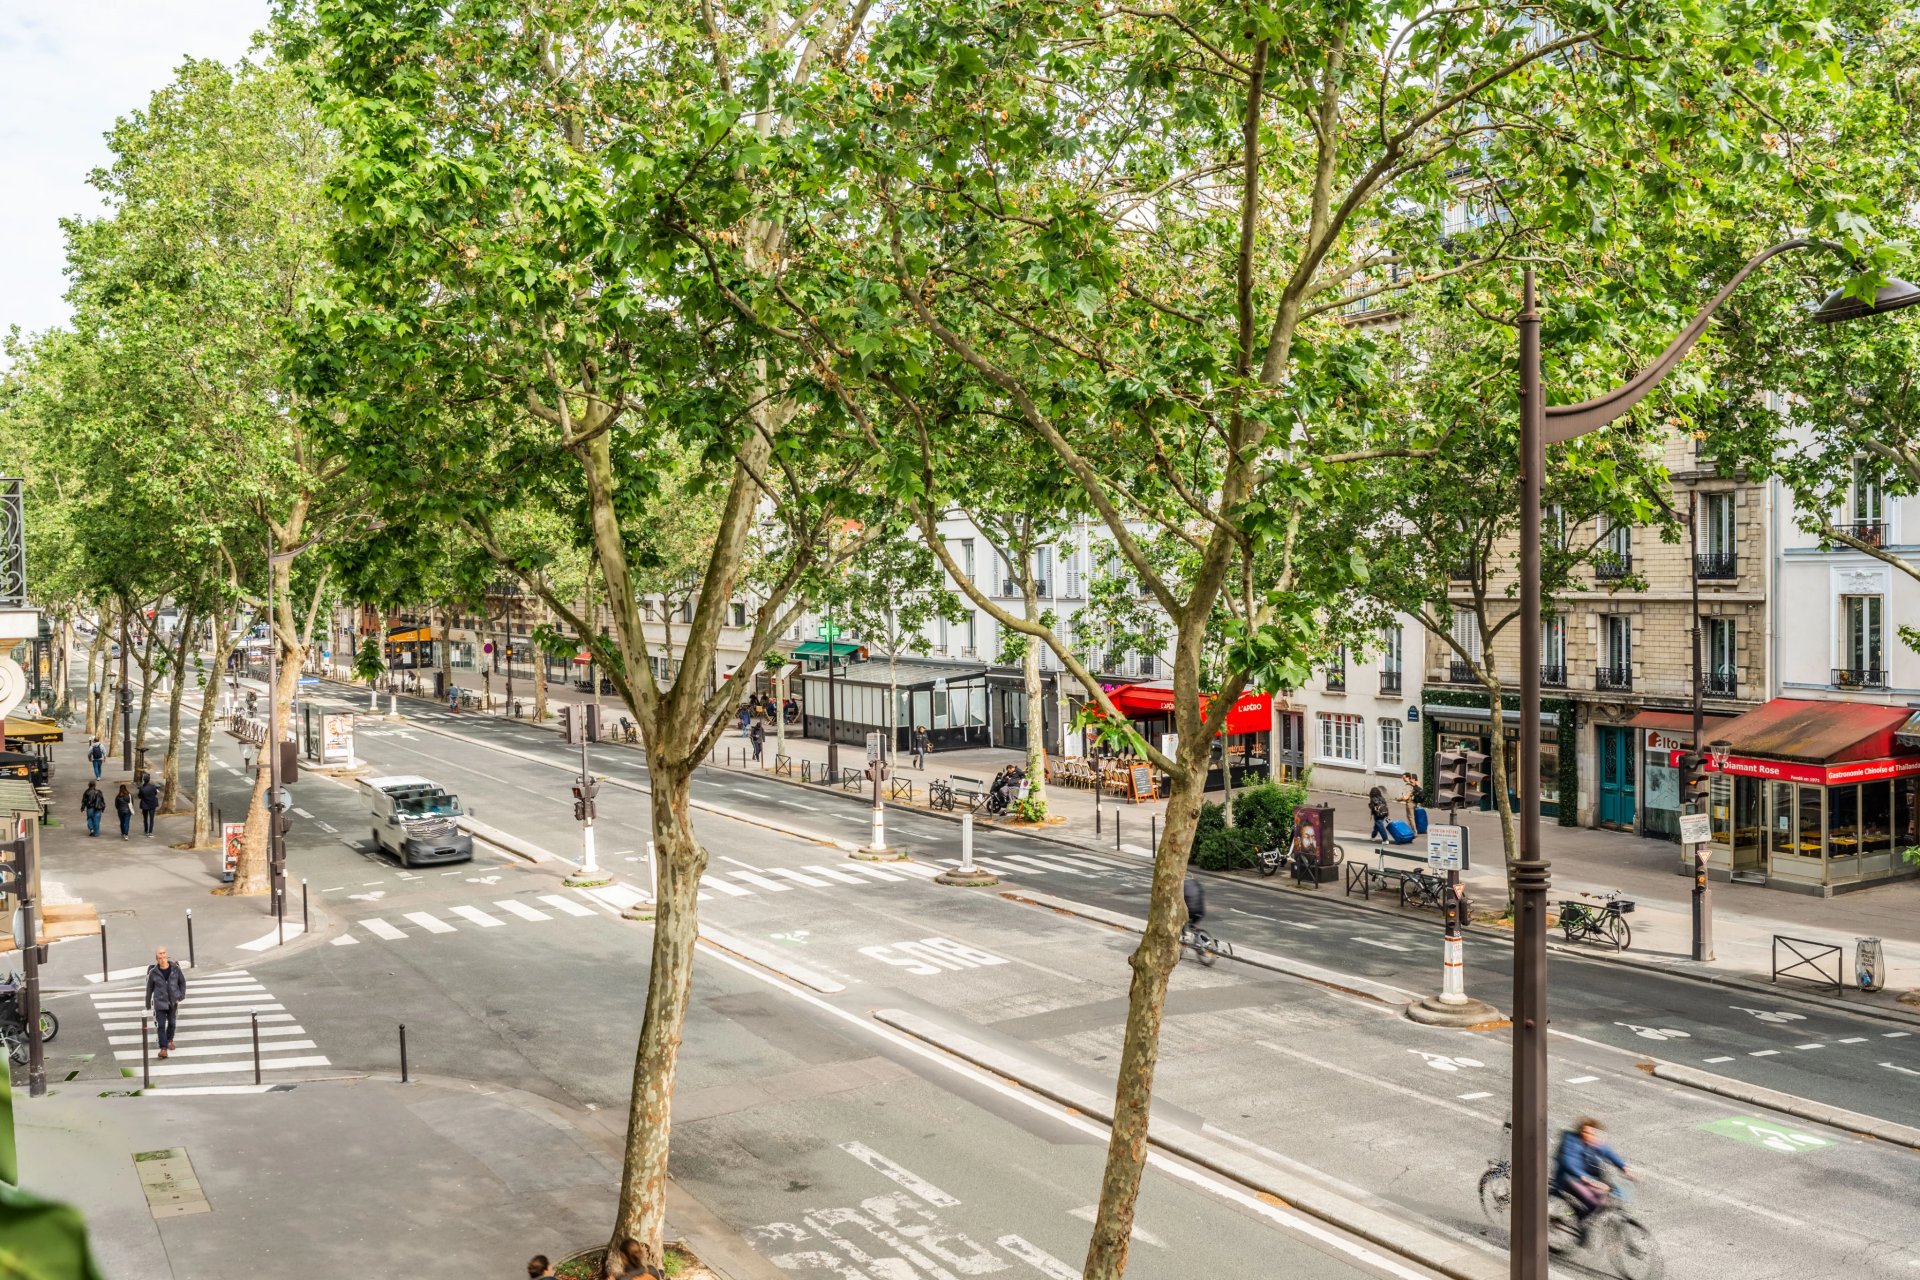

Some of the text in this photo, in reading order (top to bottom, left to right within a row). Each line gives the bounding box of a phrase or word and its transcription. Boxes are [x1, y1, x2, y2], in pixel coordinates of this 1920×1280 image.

[1238, 703, 1262, 713] L'APÉRO
[1723, 761, 1757, 773] Diamant
[1759, 765, 1780, 775] Rose
[1828, 769, 1864, 779] Gastronomie
[1864, 766, 1887, 775] Chinoise
[1888, 765, 1895, 773] et
[858, 937, 1011, 975] BUS
